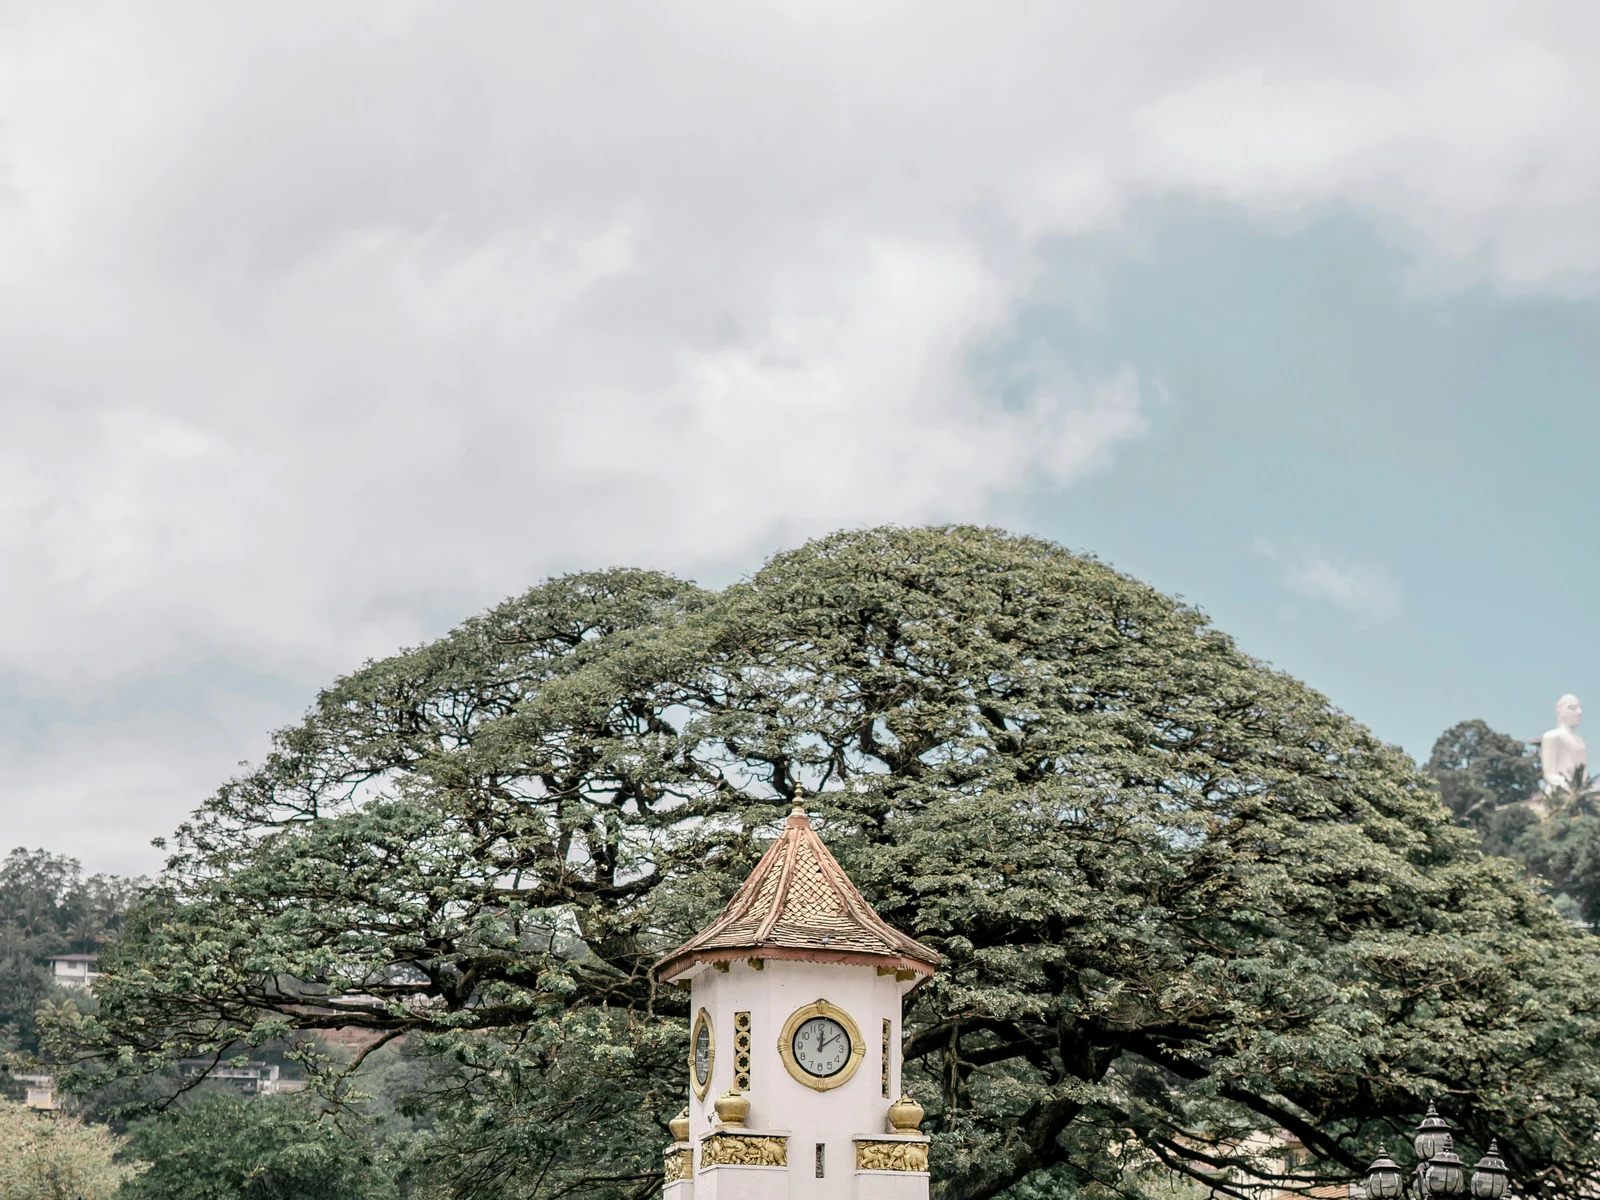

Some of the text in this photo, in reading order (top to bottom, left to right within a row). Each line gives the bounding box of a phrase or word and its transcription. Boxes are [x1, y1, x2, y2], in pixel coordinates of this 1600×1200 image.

[810, 1025, 816, 1033] 11
[818, 1023, 825, 1032] 12
[830, 1026, 833, 1035] 1
[802, 1032, 810, 1040] 10
[797, 1042, 803, 1050] 9
[839, 1045, 844, 1053] 3
[834, 1055, 840, 1063] 4
[808, 1061, 814, 1069] 7
[817, 1063, 823, 1071] 6
[827, 1062, 833, 1070] 5
